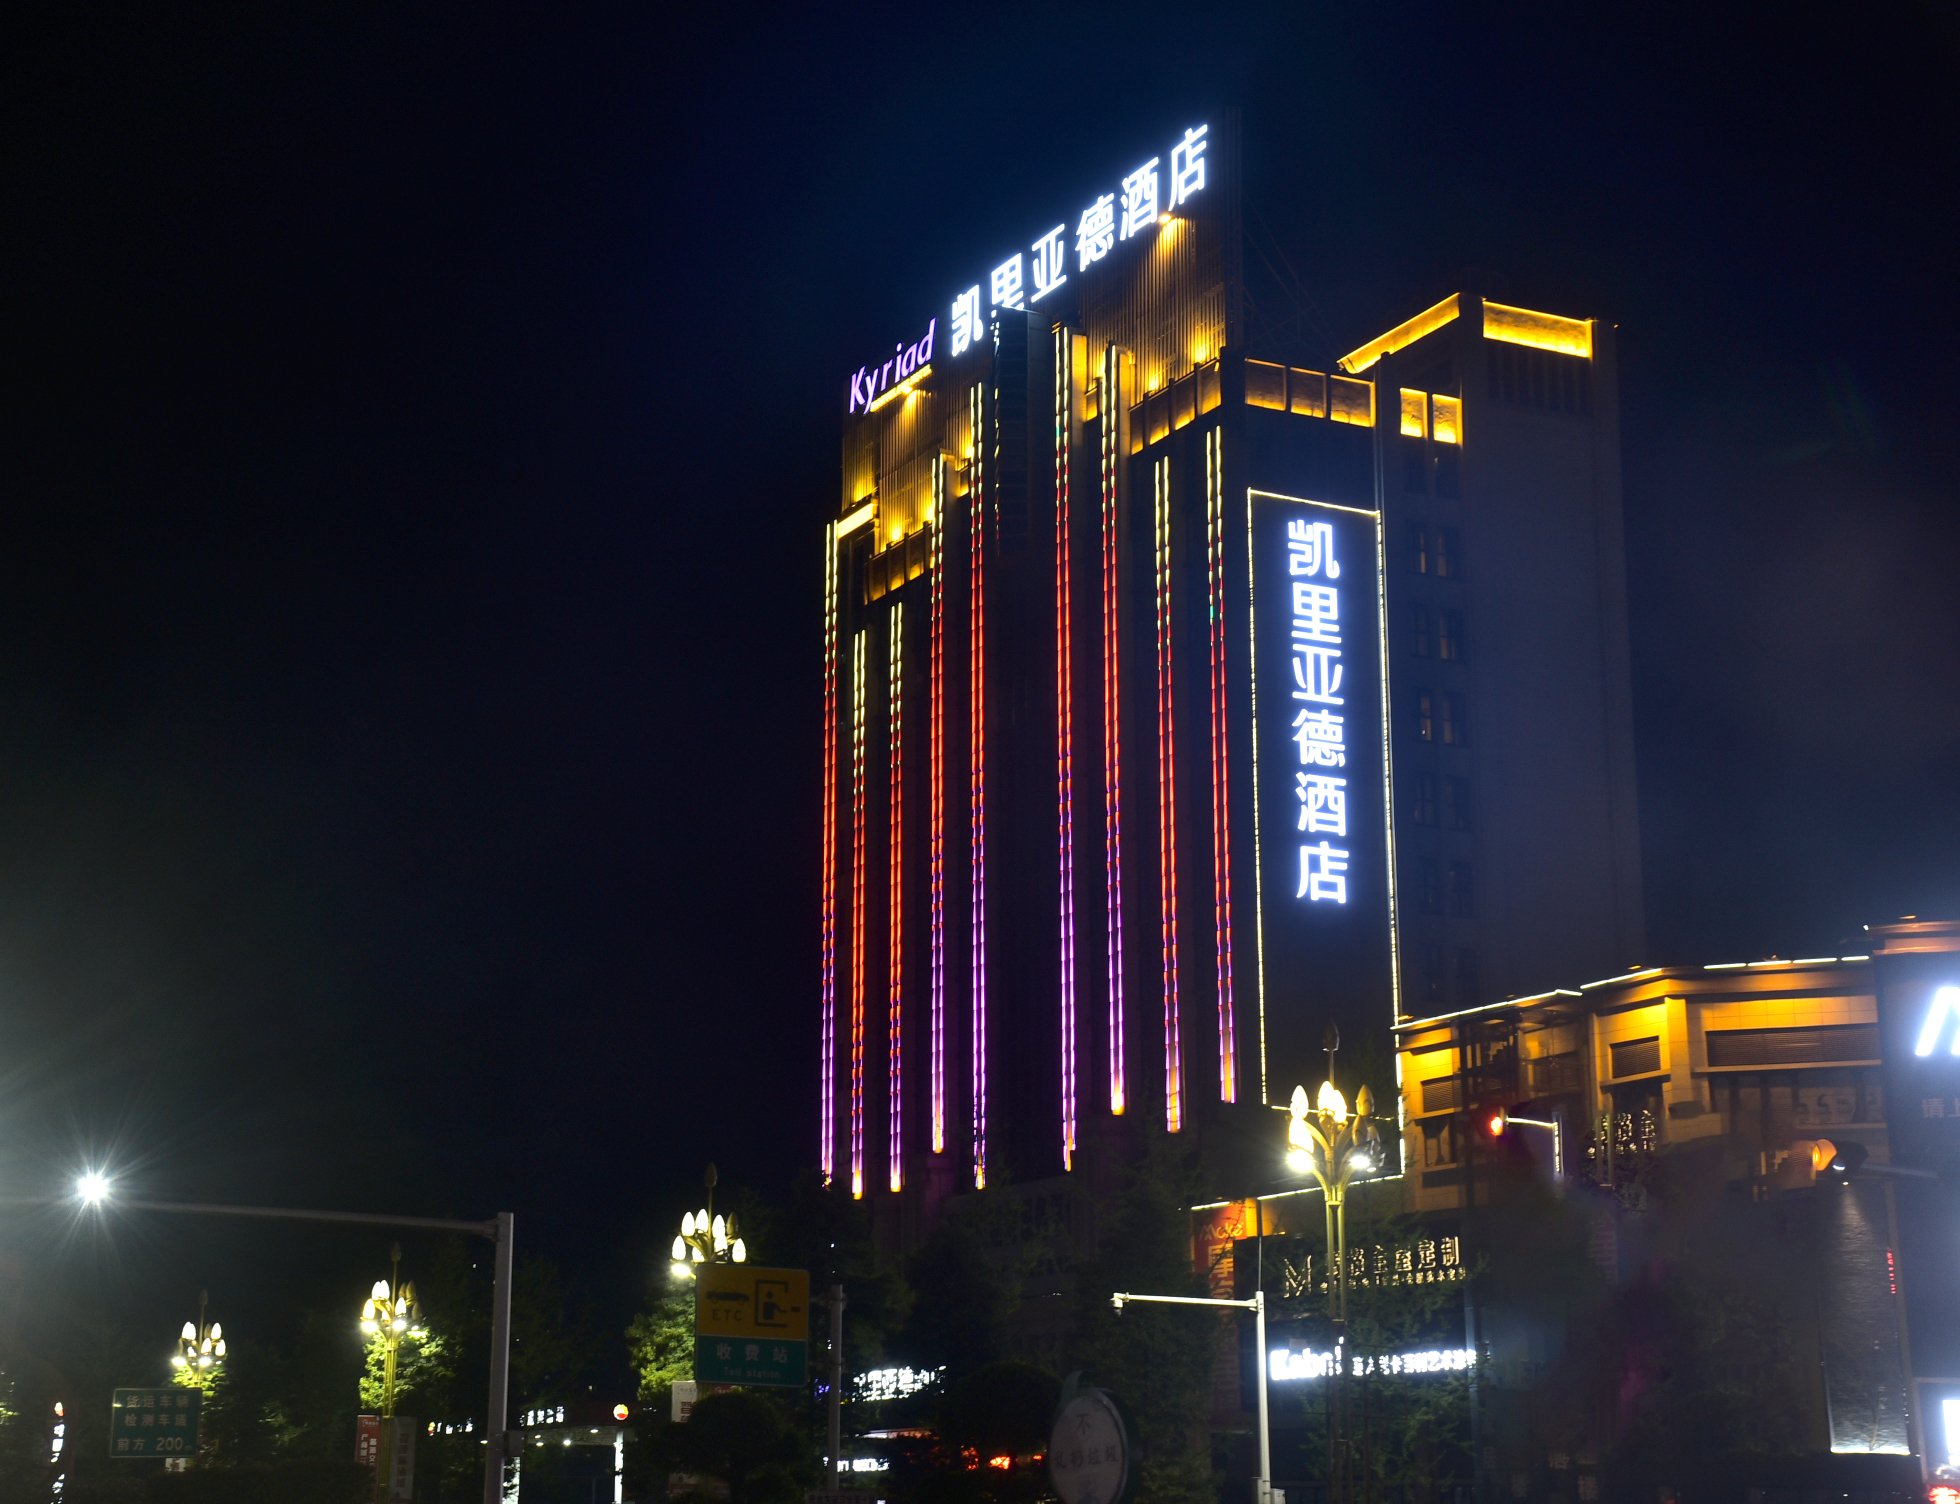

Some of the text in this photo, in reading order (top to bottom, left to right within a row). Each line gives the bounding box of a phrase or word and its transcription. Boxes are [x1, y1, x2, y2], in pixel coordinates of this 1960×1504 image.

[951, 123, 1209, 358] 凯里亚德酒店
[849, 317, 937, 415] Kyriad
[1286, 518, 1350, 905] 凯里亚德酒店
[712, 1308, 743, 1322] ETC
[716, 1342, 789, 1363] 收费站
[723, 1366, 781, 1379] Toll station
[126, 1395, 190, 1408] 货运车辆
[124, 1413, 188, 1427] 检测车道
[117, 1438, 146, 1451] 前方
